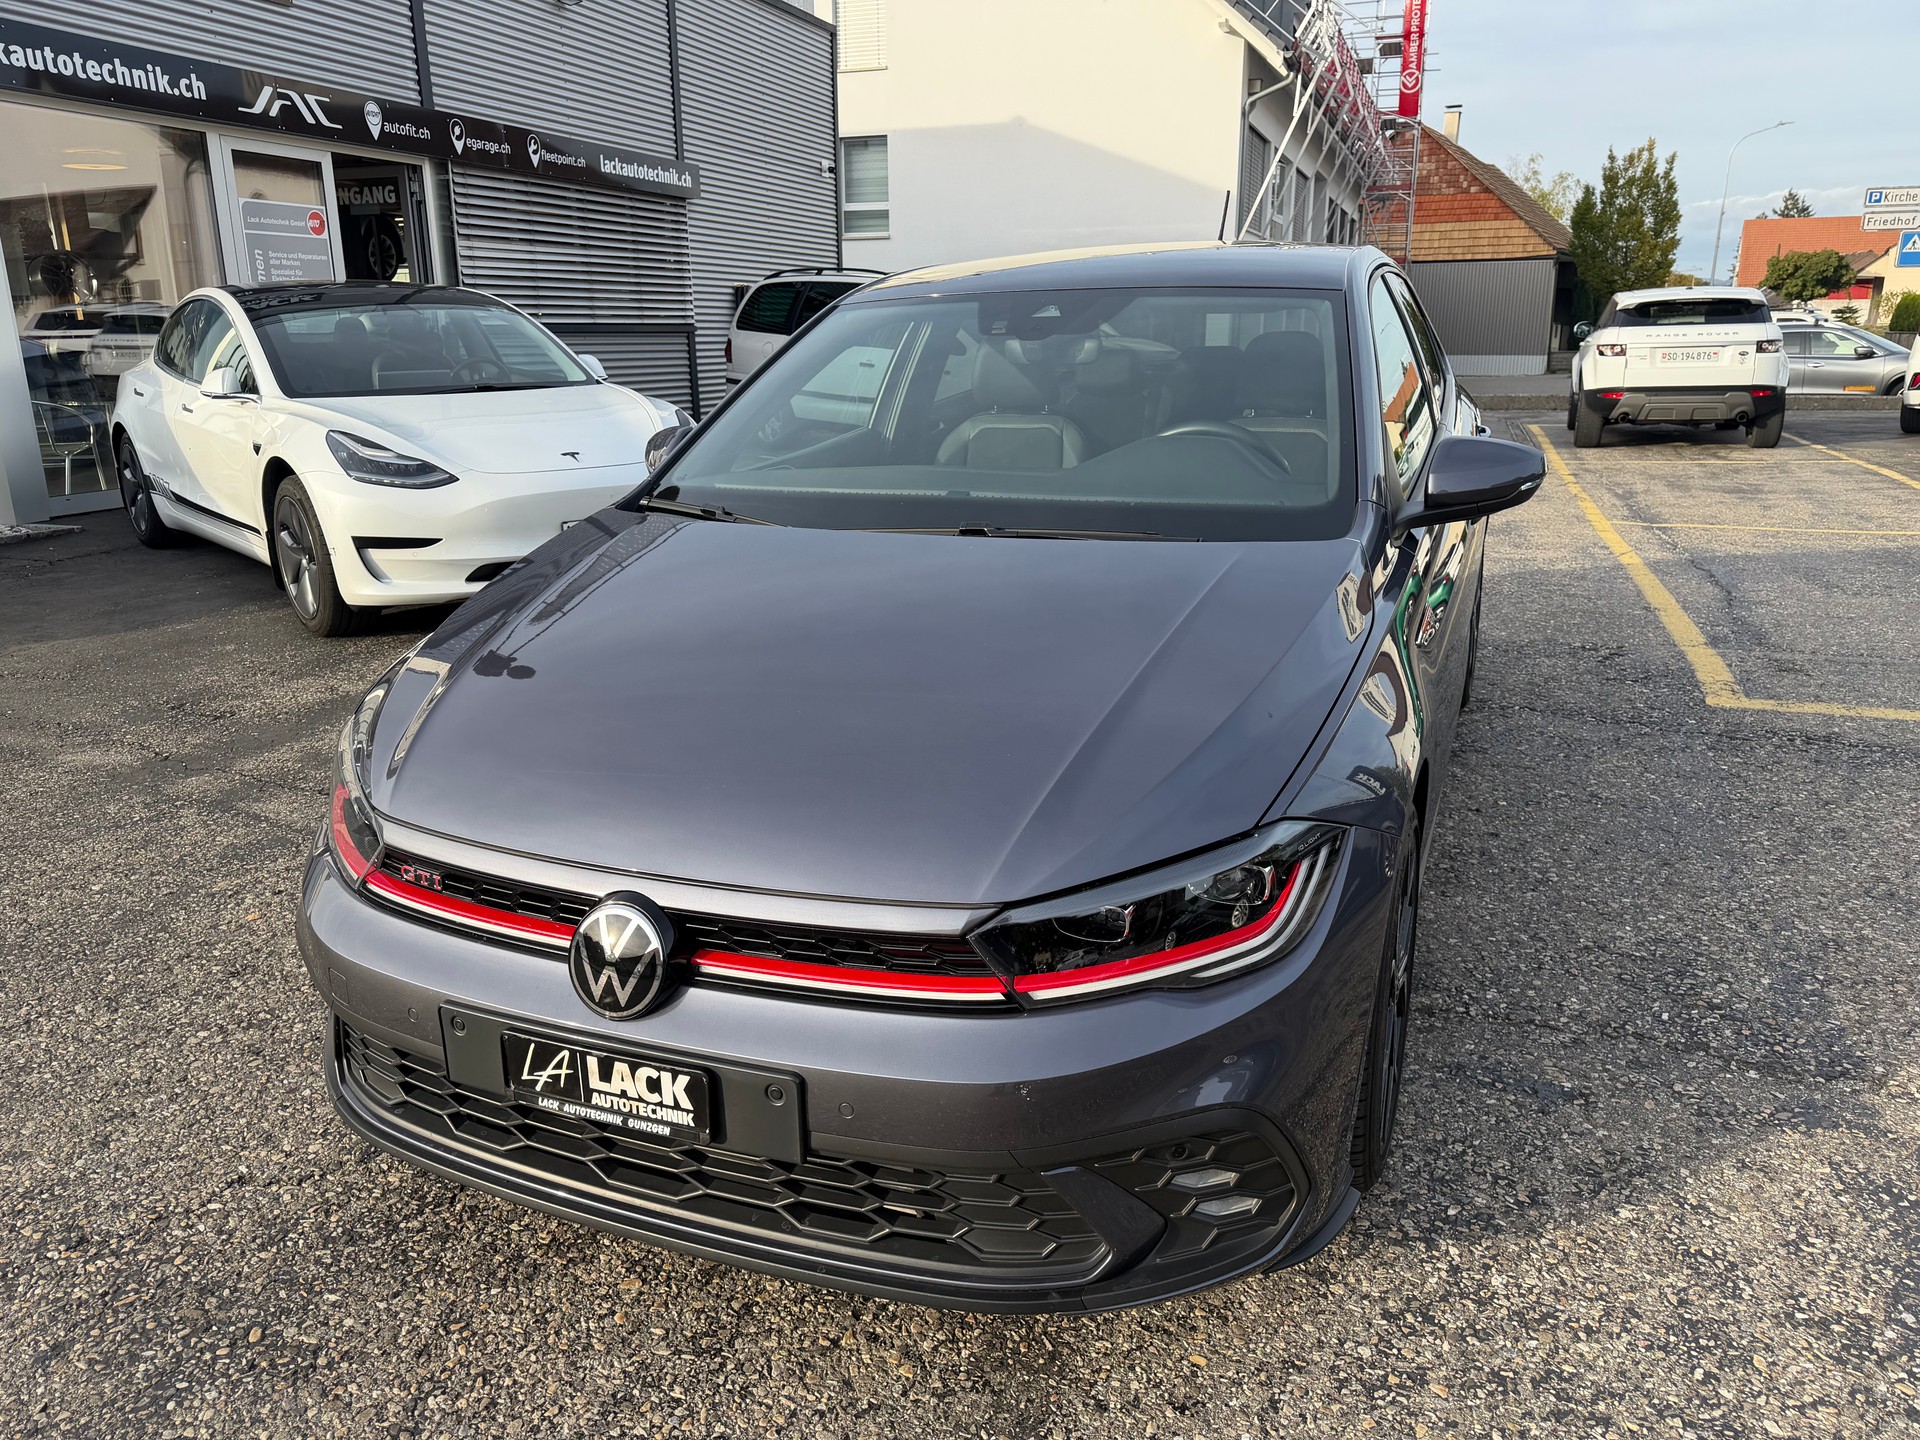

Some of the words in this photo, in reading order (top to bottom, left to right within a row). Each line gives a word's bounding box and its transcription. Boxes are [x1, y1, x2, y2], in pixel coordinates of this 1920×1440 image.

[1408, 32, 1420, 70] AMBER
[383, 121, 431, 140] autofit.ch
[466, 137, 512, 155] egarage.ch
[541, 149, 587, 168] fleetpoint.ch
[600, 154, 692, 188] lackautotechnik.ch
[1883, 190, 1919, 203] Kirche
[247, 215, 260, 223] Lack
[260, 217, 290, 226] Autotechnik
[290, 219, 306, 227] GmbH
[1866, 215, 1918, 227] Friedhof
[268, 250, 288, 259] Service
[298, 252, 328, 261] Reparaturen
[269, 258, 281, 266] aller
[281, 259, 301, 267] Marken
[270, 268, 295, 276] Spezialist
[401, 865, 442, 890] GTI
[586, 1054, 695, 1111] LACK
[538, 1096, 559, 1111] LACK
[563, 1102, 623, 1126] AUTOTECHNIK
[628, 1114, 671, 1136] GUNZGEN
[591, 1092, 696, 1127] AUTOTECHNIK
